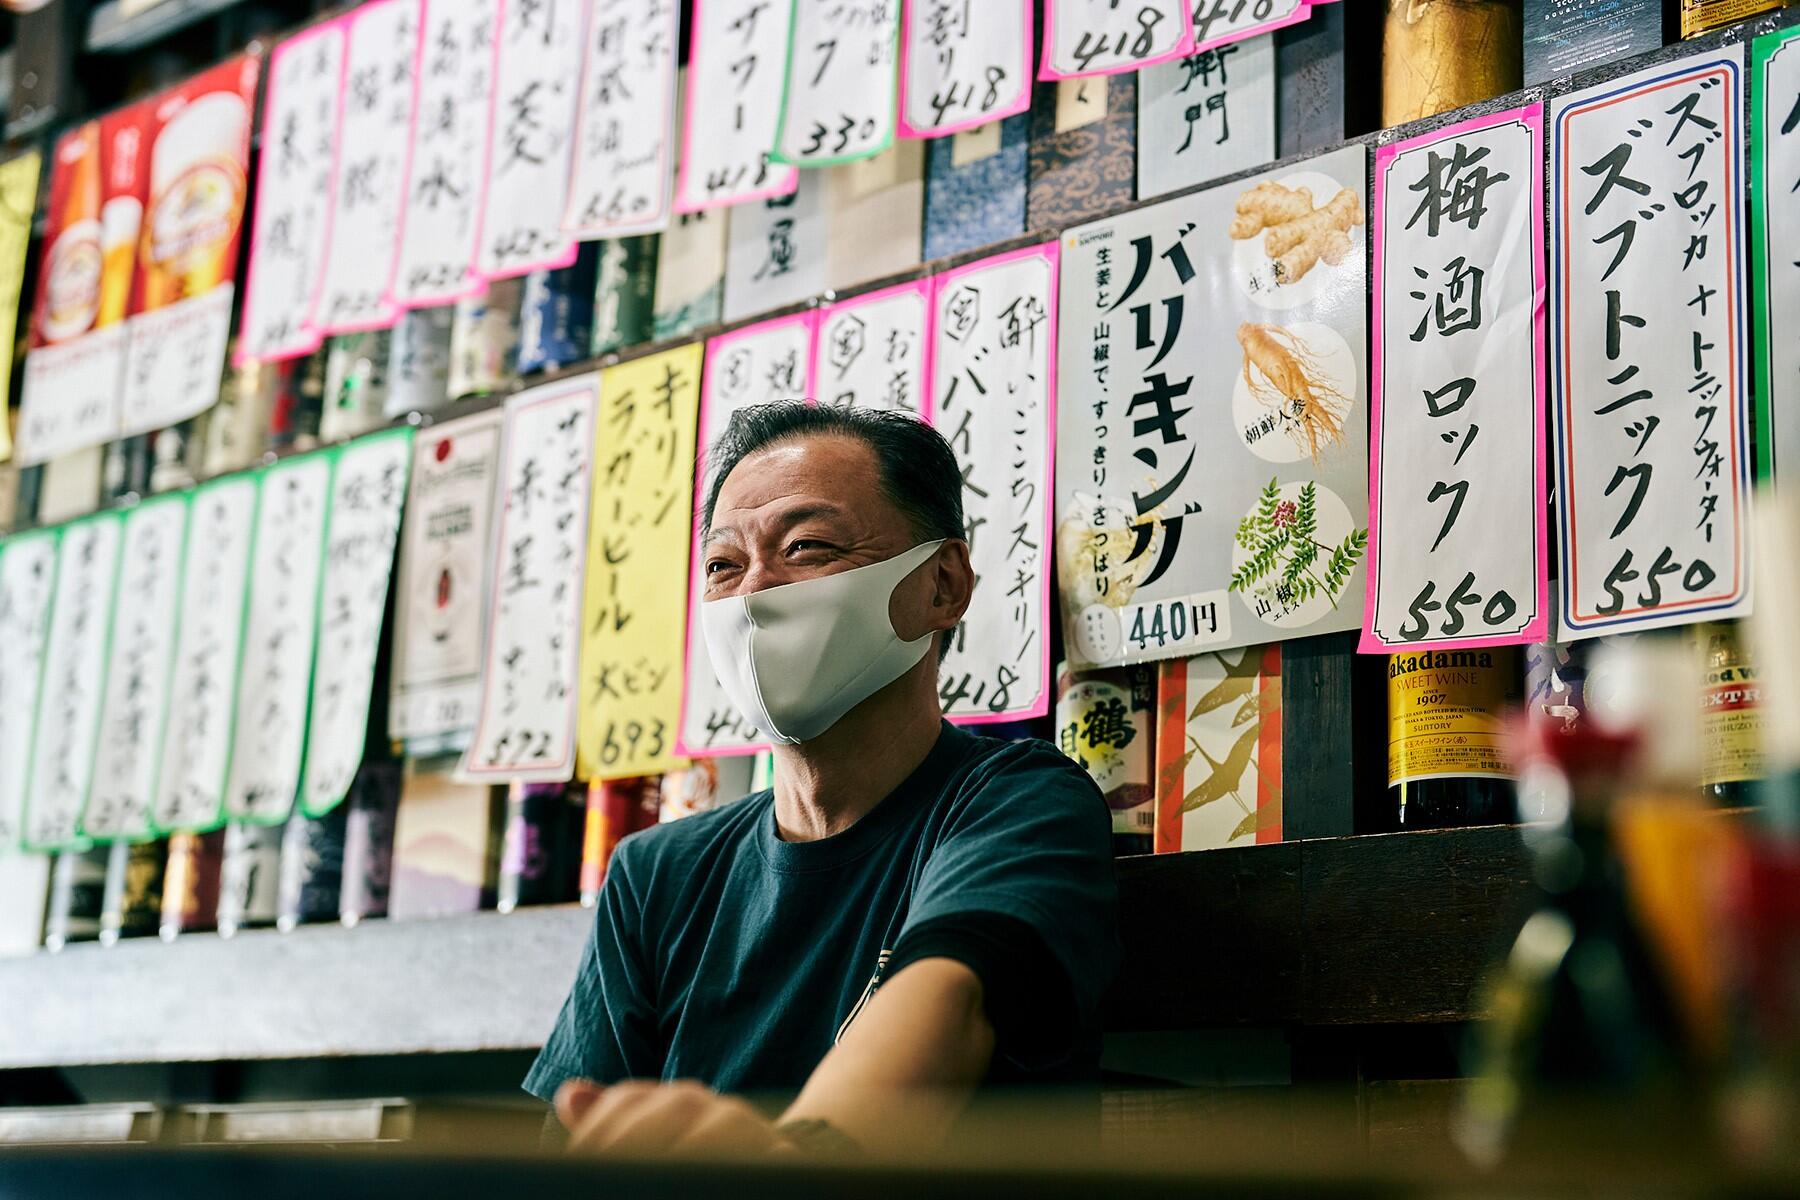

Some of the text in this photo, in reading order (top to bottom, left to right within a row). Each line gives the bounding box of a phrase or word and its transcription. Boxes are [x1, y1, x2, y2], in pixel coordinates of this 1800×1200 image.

[1073, 8, 1164, 70] 418
[931, 66, 1006, 126] 418
[801, 113, 876, 155] 330
[1404, 143, 1511, 554] 梅酒ロック
[1580, 119, 1666, 540] ズブトニック
[1101, 222, 1203, 588] バリキング
[651, 363, 690, 529] キリン
[590, 387, 651, 634] ラガービール
[1398, 571, 1517, 642] 550
[1595, 546, 1716, 617] 550
[939, 664, 1020, 712] 418
[1396, 671, 1479, 693] SWEET WINE
[1416, 694, 1448, 707] 1907
[600, 718, 667, 766] 693
